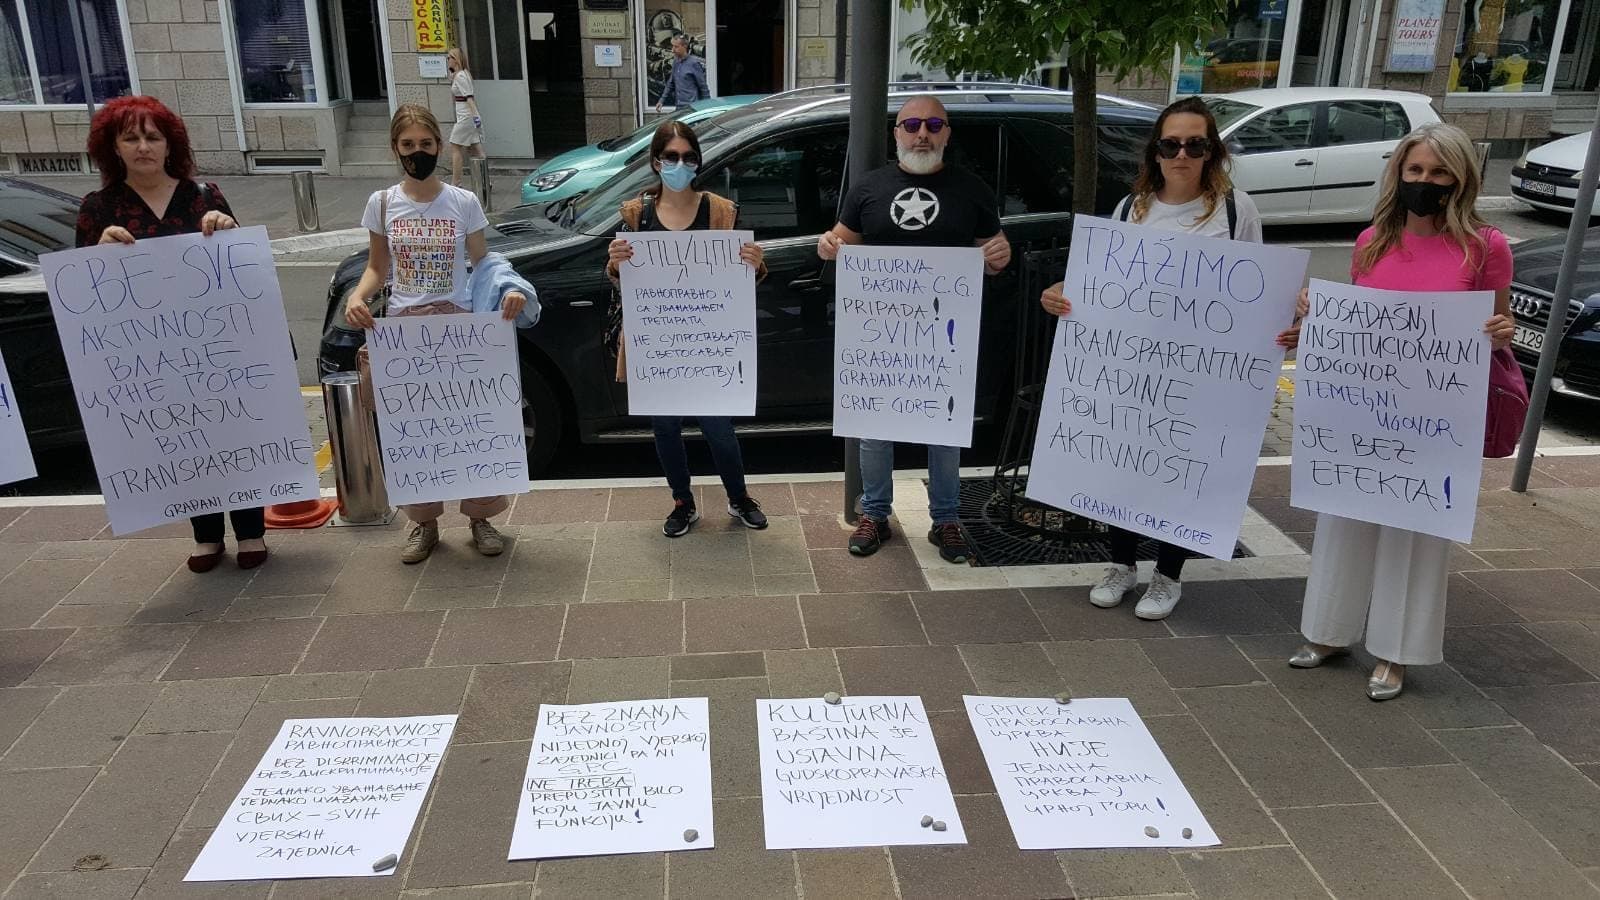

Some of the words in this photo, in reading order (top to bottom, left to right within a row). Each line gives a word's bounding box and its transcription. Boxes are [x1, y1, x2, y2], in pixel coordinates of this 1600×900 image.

[1398, 30, 1434, 39] TOURS
[21, 155, 81, 172] MAKAZIĆI
[428, 228, 456, 237] ГОРА
[844, 254, 934, 274] KULTURNA
[1080, 226, 1265, 303] TRAŽIMO
[635, 288, 716, 300] РАВНОПРАВНО
[724, 289, 733, 299] И
[637, 304, 651, 313] СА
[1083, 275, 1234, 334] HOĆEMO
[81, 302, 255, 355] AKTIVNOSTI
[641, 316, 706, 326] ТРЕТИРАТИ
[372, 324, 408, 351] МИ
[414, 323, 506, 353] ДАНАС
[633, 334, 651, 347] НЕ
[1306, 323, 1480, 365] INSTITUCIONALNI
[1061, 320, 1273, 391] TRANSPARENTNE
[1304, 353, 1411, 390] ODGOVOR
[1426, 368, 1469, 395] NA
[1064, 353, 1194, 415] VLADINE
[378, 373, 521, 415] БРАНИМО
[840, 394, 884, 412] CRNE
[120, 397, 263, 439] MORAJU
[390, 413, 496, 442] УСТАВНЕ
[1061, 387, 1197, 452] POLITIKE
[1376, 409, 1463, 447] UGOVOR
[155, 428, 211, 456] BITI
[387, 433, 525, 464] ВРИЈЕДНОСТИ
[1351, 433, 1417, 465] BEZ
[103, 437, 312, 500] TRANSPARENTNE
[1050, 422, 1209, 500] AKTIVNOSTI
[395, 469, 457, 494] ЦРНЕ
[466, 461, 523, 482] ГОРЕ
[229, 488, 263, 503] CRNE
[270, 482, 304, 497] GORE
[1135, 513, 1169, 535] CRNE
[1173, 524, 1214, 546] GORE
[546, 710, 598, 725] BEZ
[768, 702, 926, 724] KULTURNA
[974, 703, 1072, 717] СРПСКА
[289, 722, 453, 739] RAVNOPRAVNOST
[553, 721, 657, 736] JAVNOSTI
[985, 717, 1131, 728] ПРАВОСЛАВНА
[541, 738, 628, 754] NIJEDNOJ
[640, 732, 707, 751] VJERSKOJ
[1029, 740, 1109, 758] НИЈЕ
[274, 758, 306, 769] BEZ
[537, 752, 618, 765] ZAJEDNICI
[630, 750, 648, 759] PA
[656, 749, 674, 757] NI
[776, 745, 908, 764] USTAVNA
[1002, 762, 1107, 773] ЈЕДИНА
[529, 778, 557, 790] NE
[570, 776, 631, 789] TREBA
[1014, 774, 1162, 787] ПРАВОСЛАВНА
[240, 796, 306, 806] JEDNAKO
[531, 787, 632, 802] PREPUSTITI
[643, 786, 683, 796] BILO
[779, 788, 913, 810] VRIJEDNOST
[327, 808, 381, 821] SVIH
[532, 805, 578, 817] KOJU
[589, 799, 656, 811] JAVNU
[236, 829, 325, 843] VJERSKIH
[256, 842, 360, 861] ZAJEDNICA
